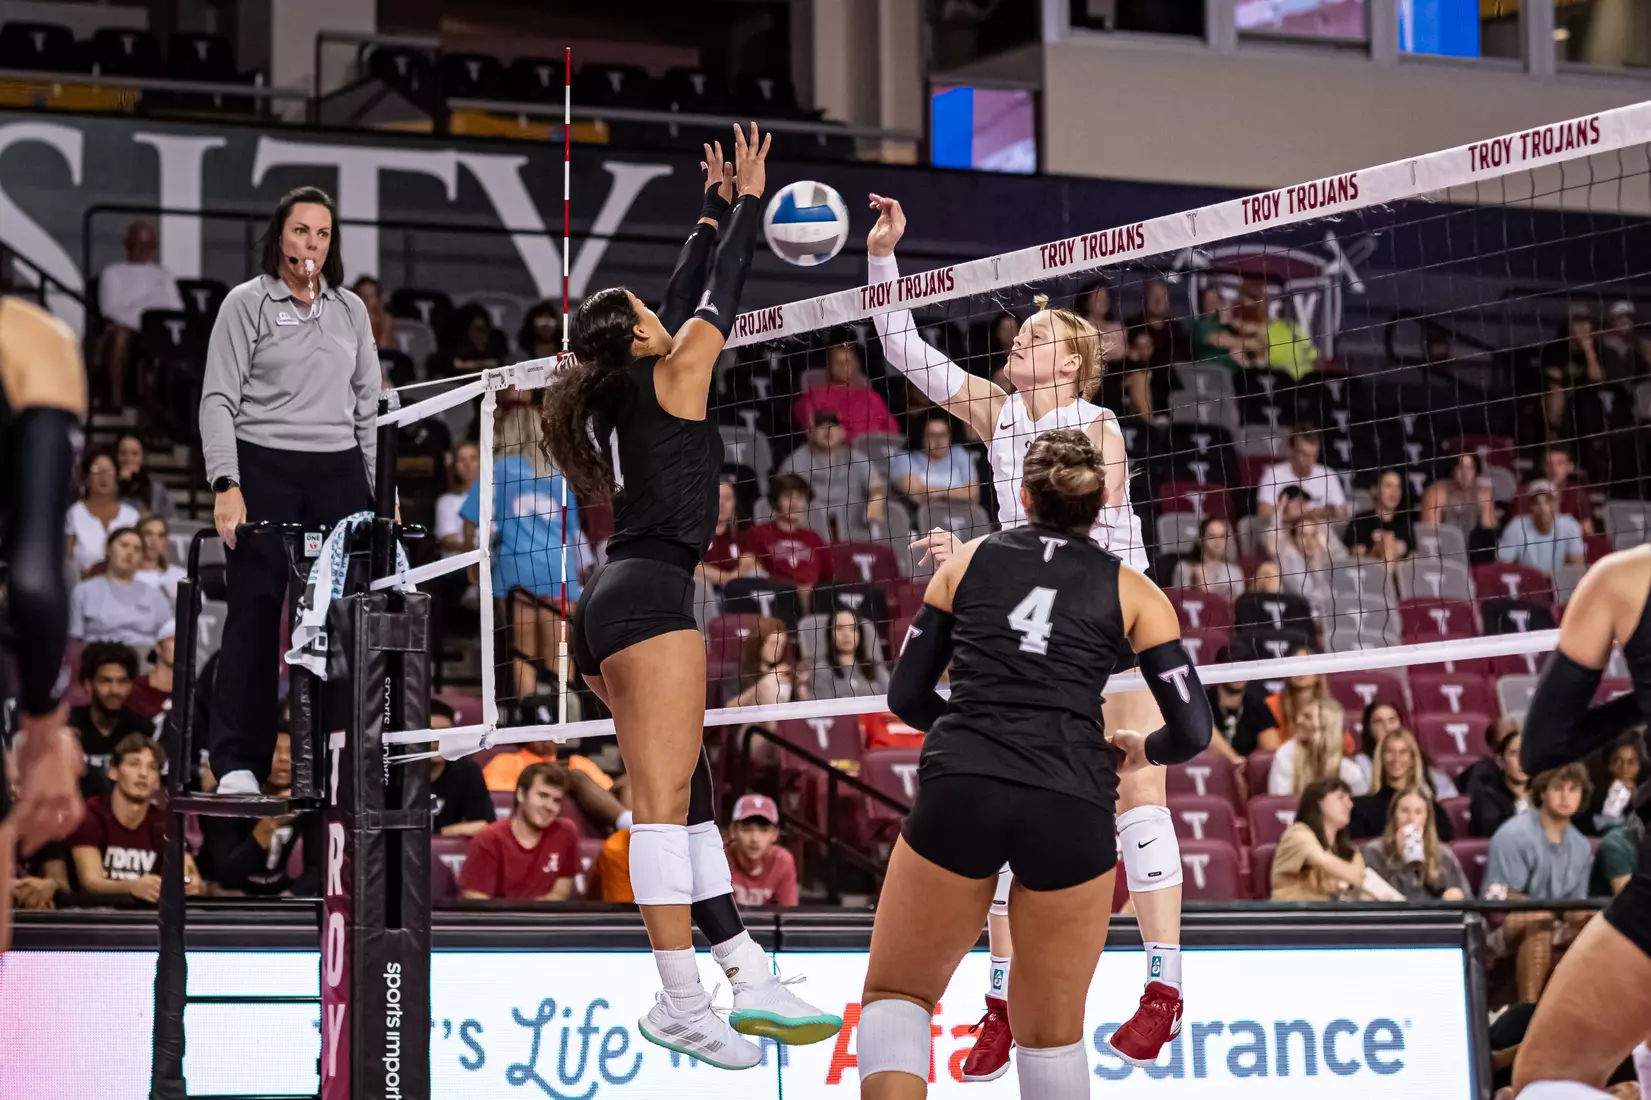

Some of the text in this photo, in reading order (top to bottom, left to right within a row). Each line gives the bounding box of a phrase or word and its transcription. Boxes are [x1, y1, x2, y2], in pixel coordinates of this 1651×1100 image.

[1467, 117, 1600, 172] TROY TROJANS
[1241, 173, 1359, 225] TROY TROJANS
[1040, 222, 1145, 270] TROY TROJANS
[861, 266, 956, 310] TROY TROJANS
[734, 305, 784, 338] TROJANS
[1007, 586, 1058, 656] 4
[327, 730, 346, 1076] TROY
[382, 962, 403, 1028] sports
[430, 1018, 486, 1069] 's
[505, 998, 643, 1100] Life
